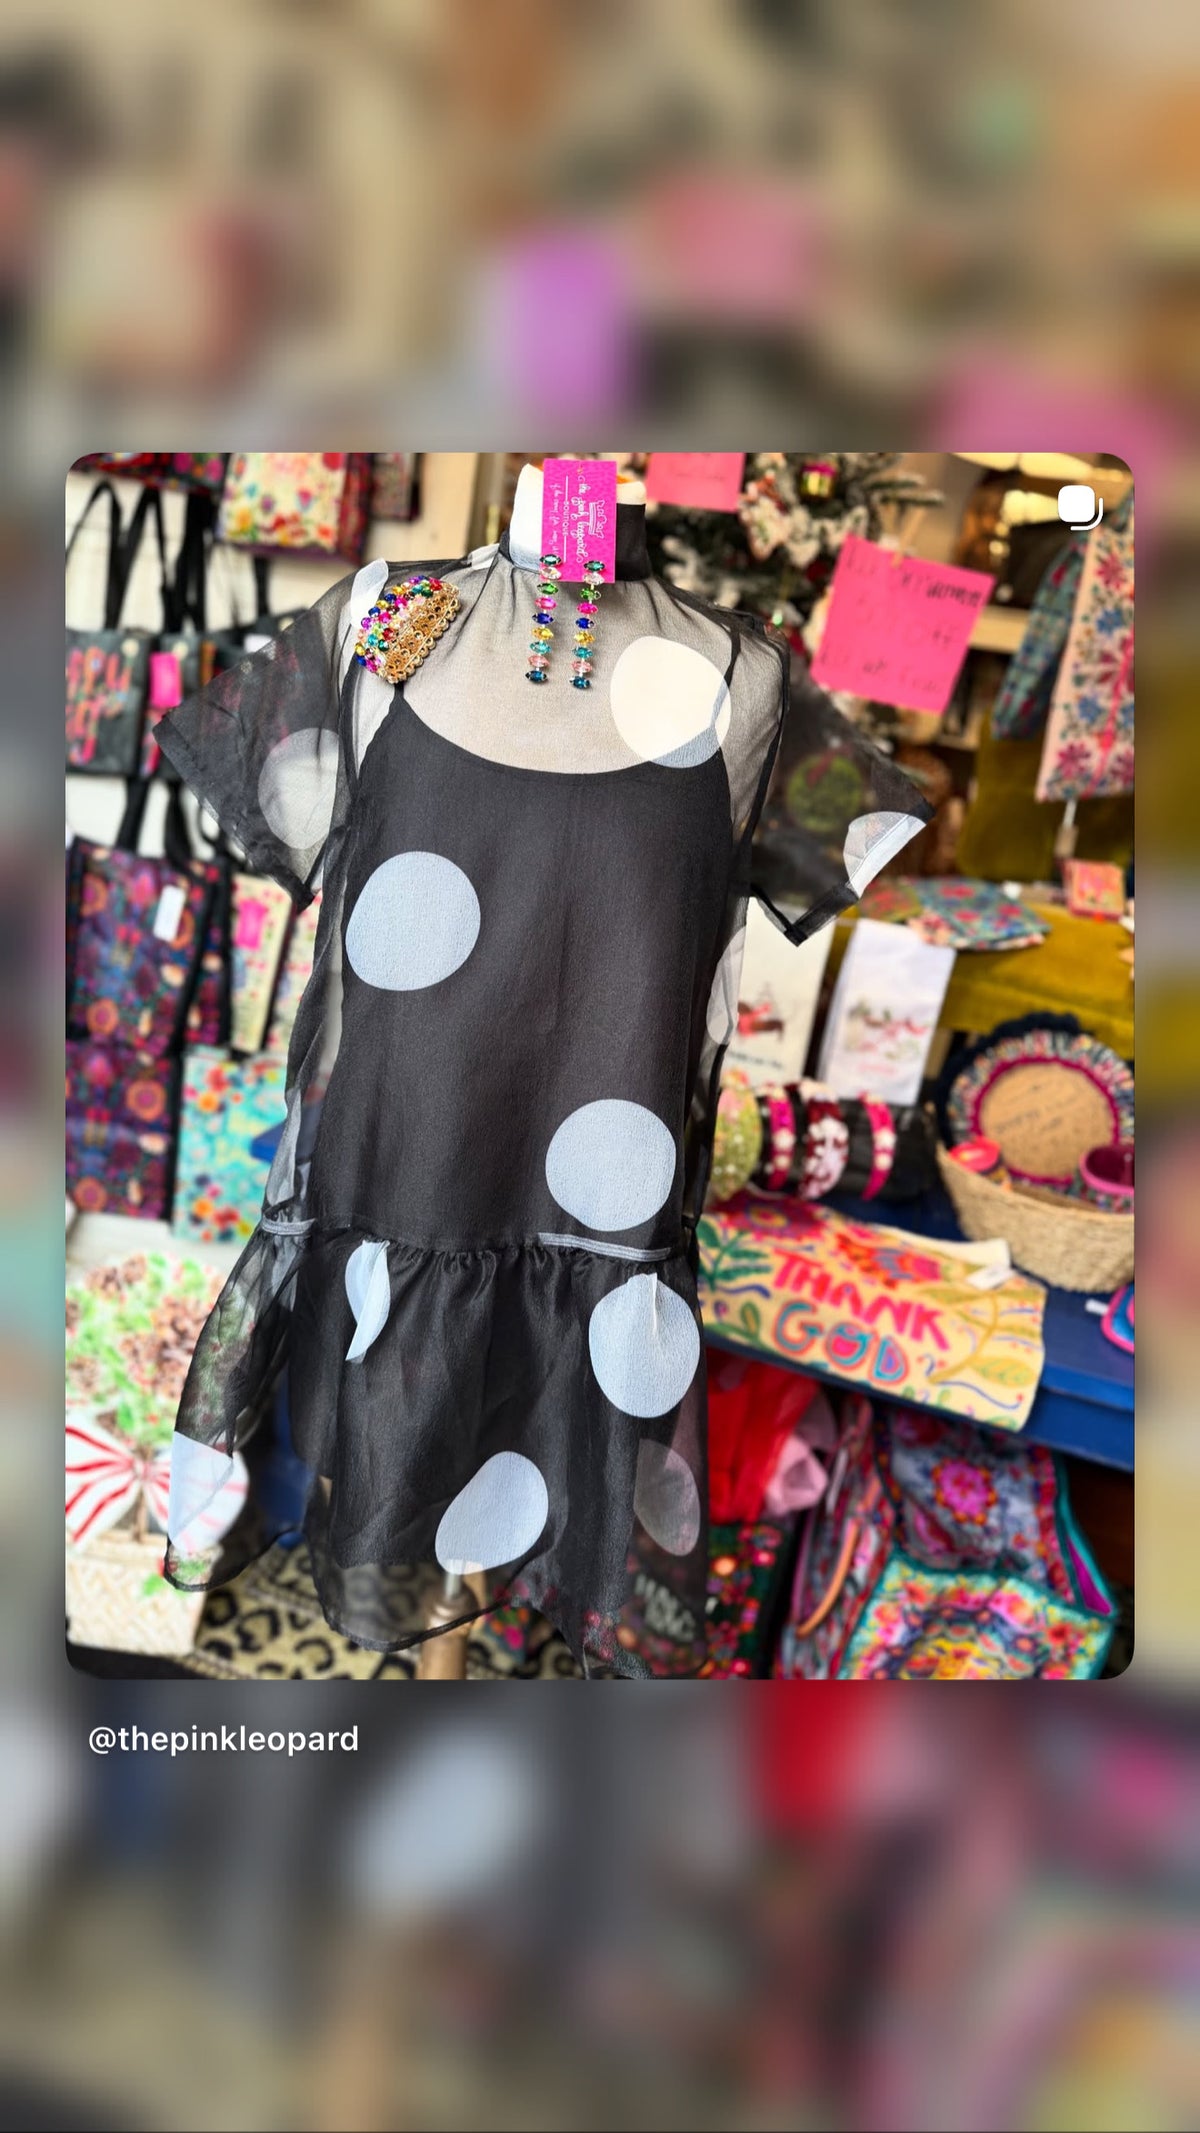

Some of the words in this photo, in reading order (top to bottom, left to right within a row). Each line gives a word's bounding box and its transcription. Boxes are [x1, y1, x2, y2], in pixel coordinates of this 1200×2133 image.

[562, 501, 570, 536] BOUTIQUE
[773, 1247, 949, 1351] THANK
[772, 1300, 910, 1386] GOD
